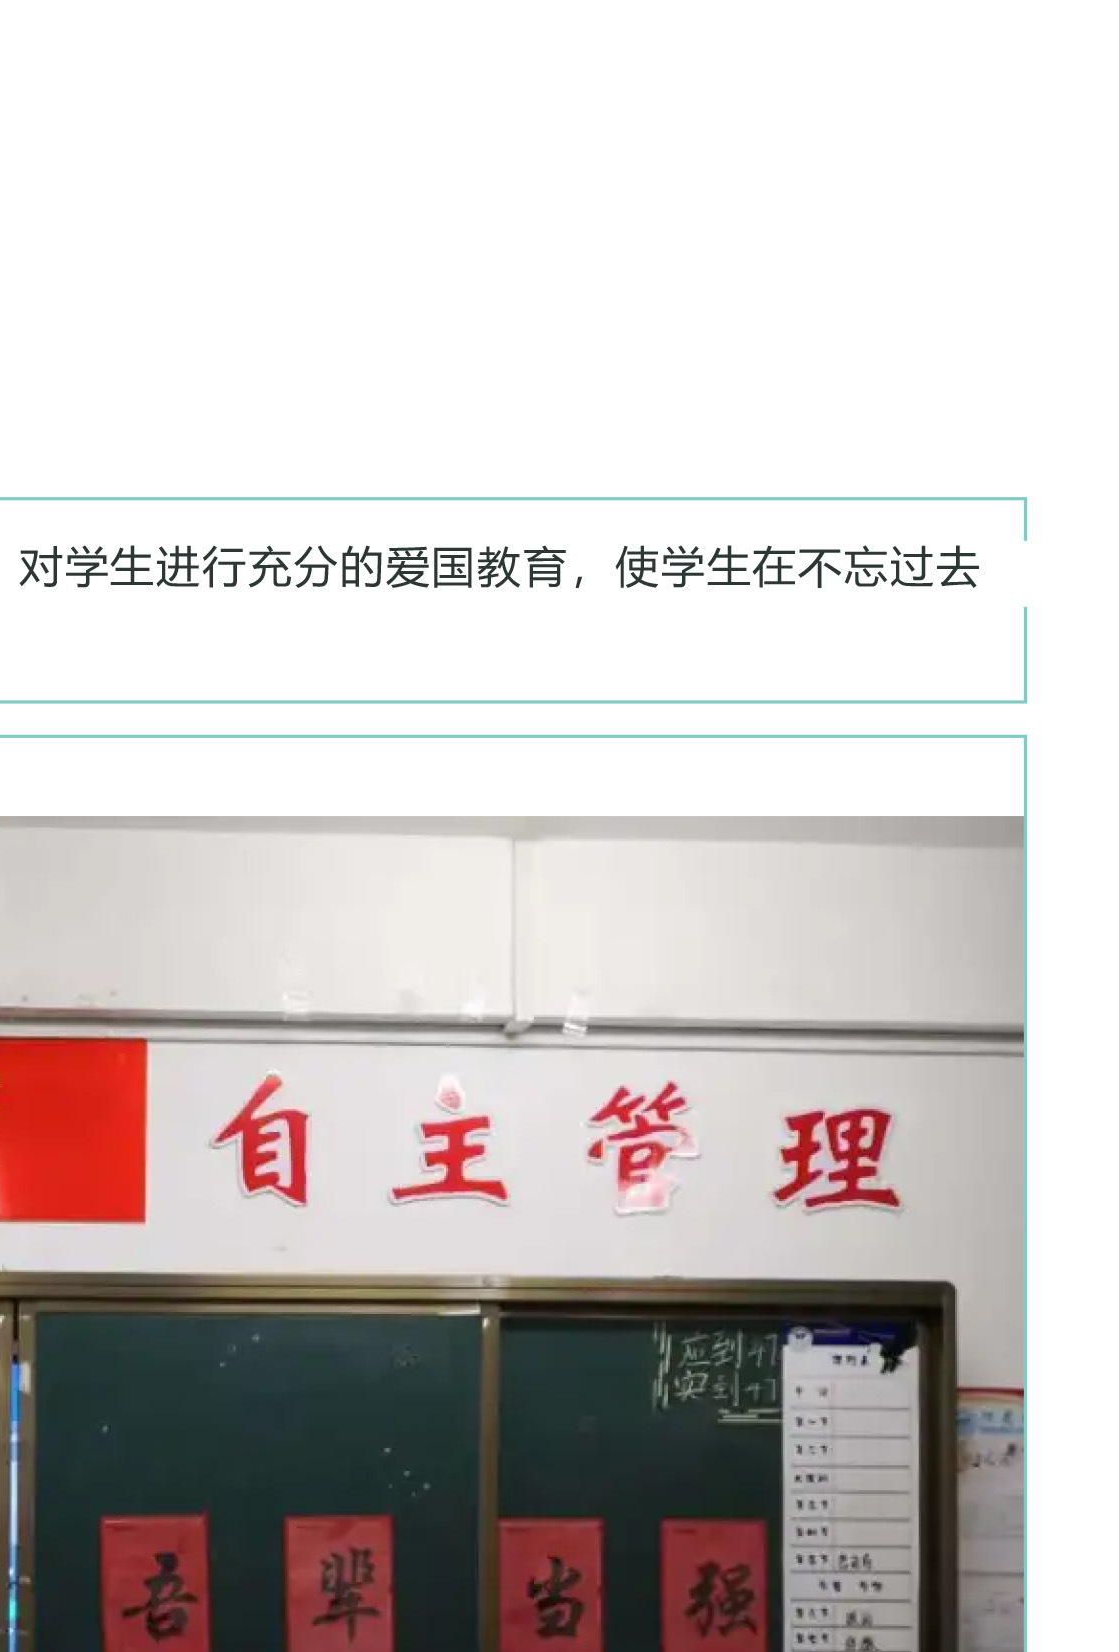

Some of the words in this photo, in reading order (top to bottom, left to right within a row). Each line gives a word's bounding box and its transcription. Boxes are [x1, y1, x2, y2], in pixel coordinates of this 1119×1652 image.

[216, 1078, 900, 1210] 自主管理
[122, 1546, 760, 1643] 吾辈当强
